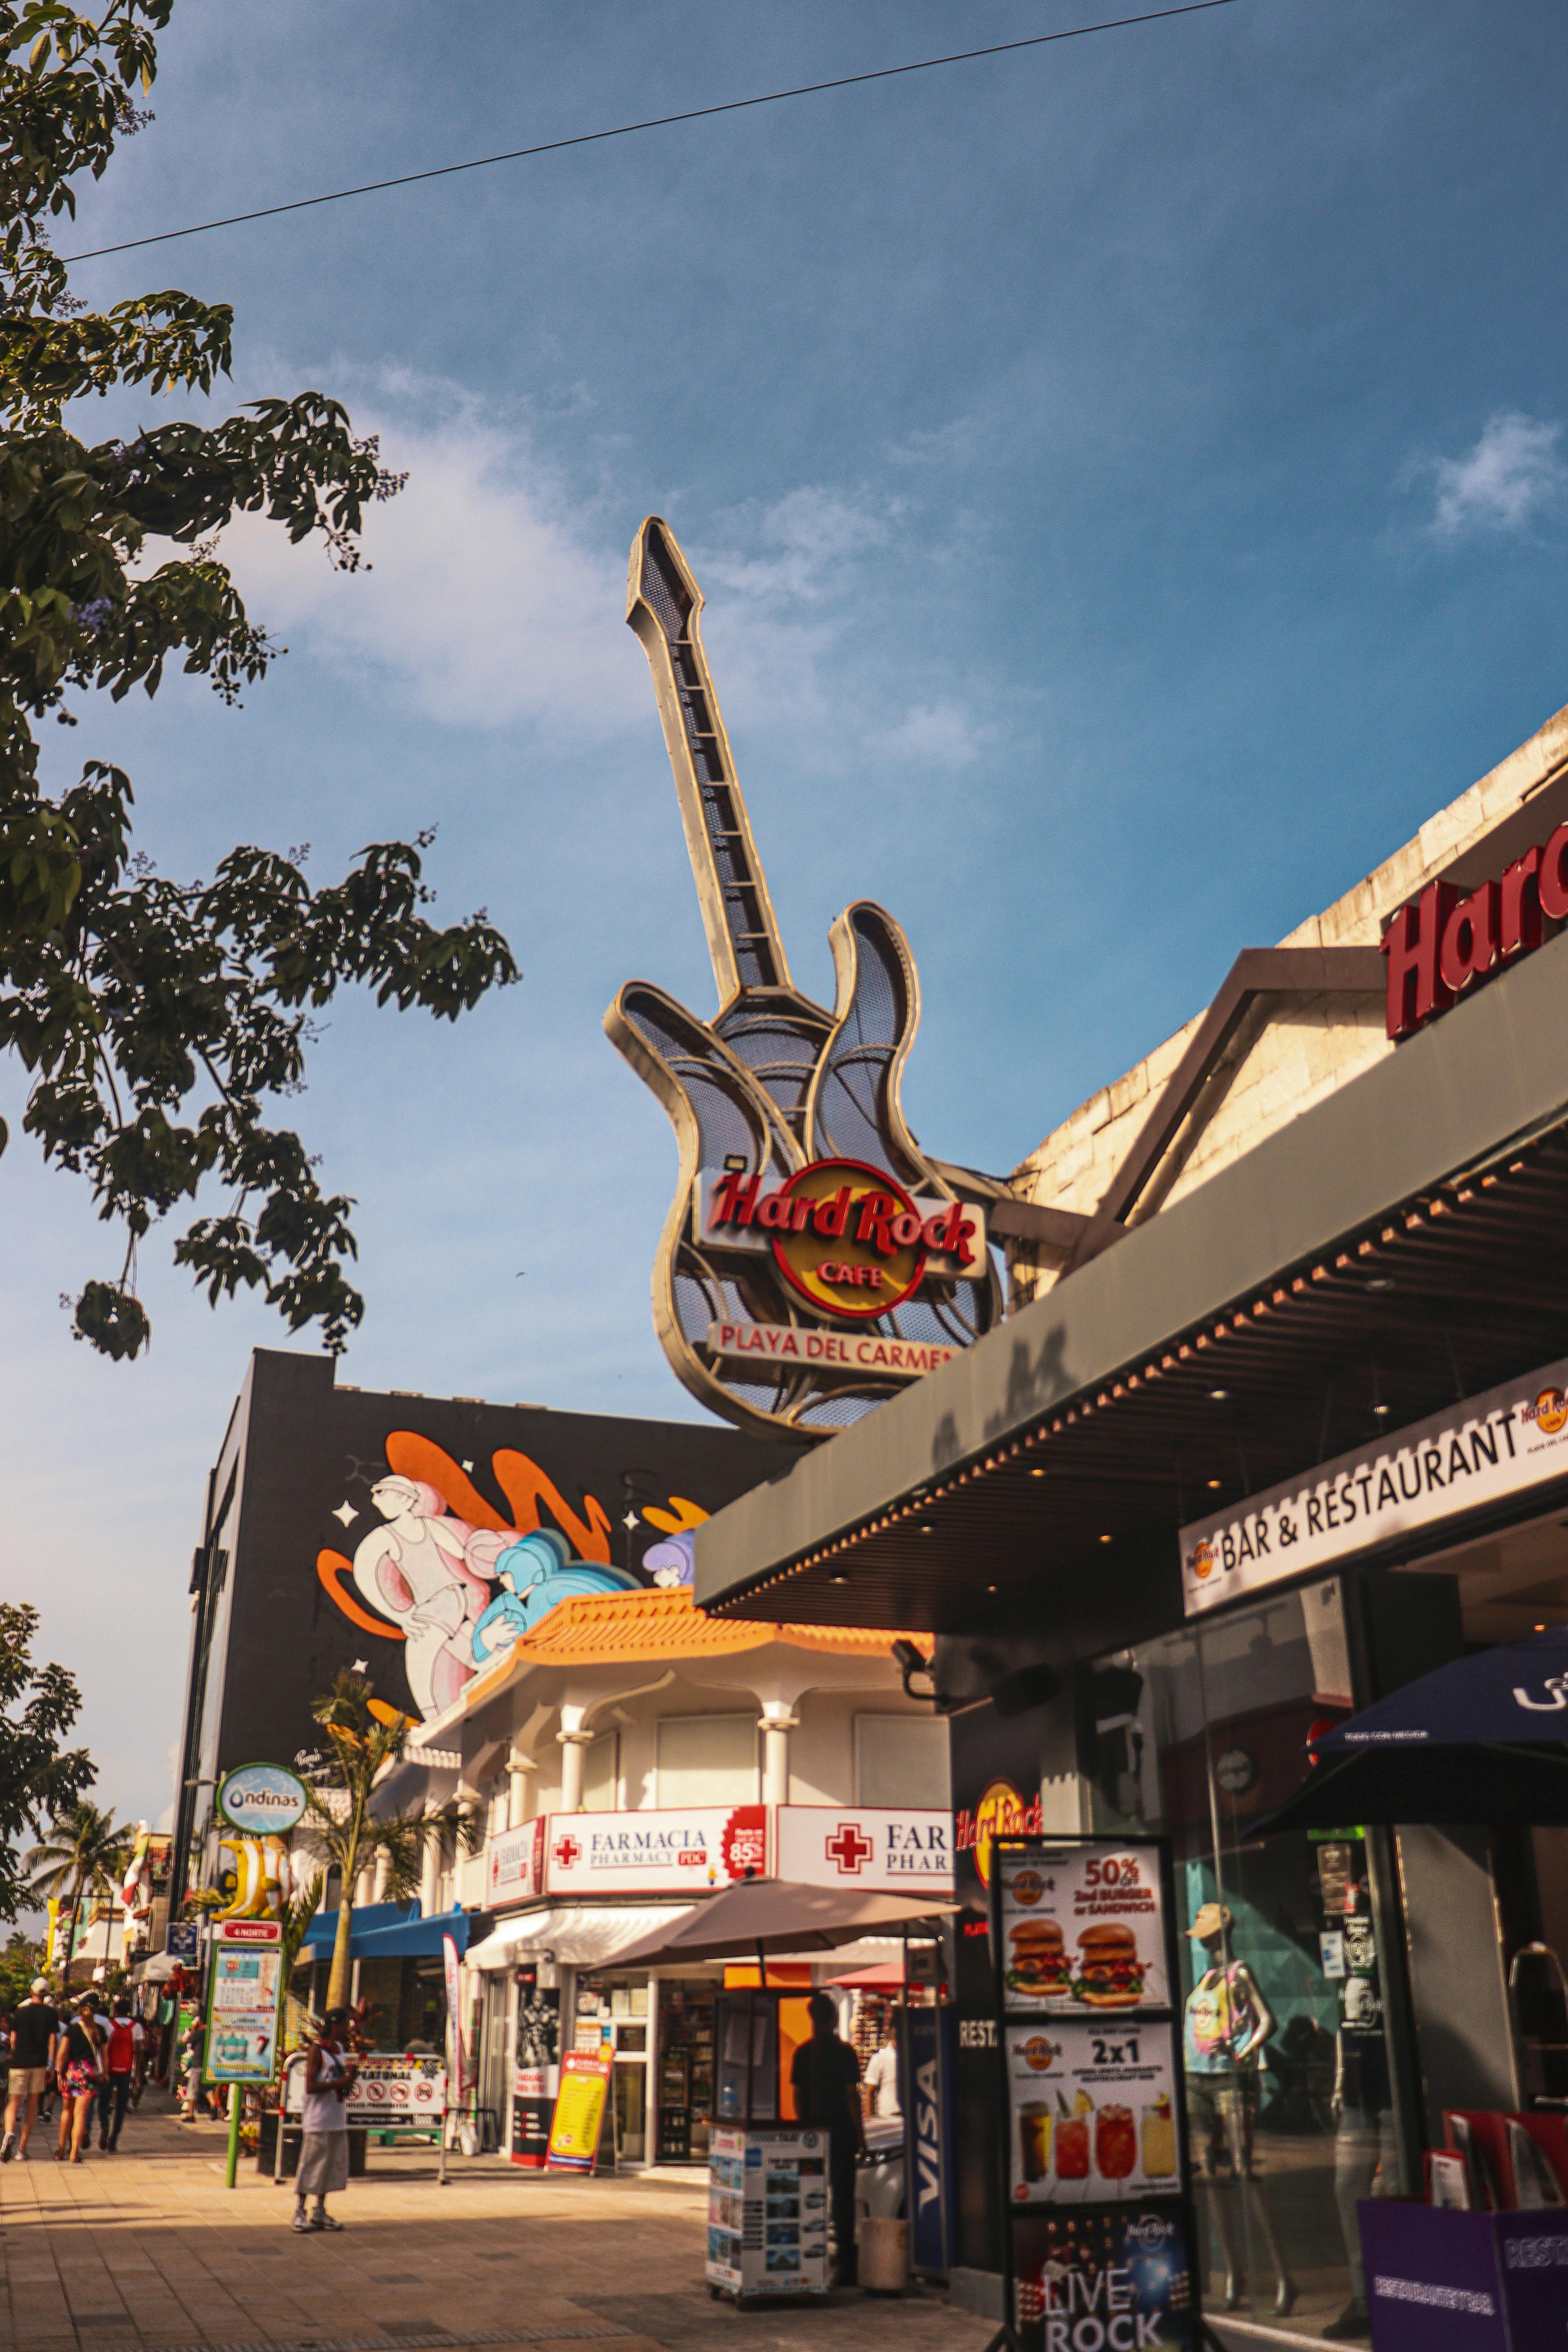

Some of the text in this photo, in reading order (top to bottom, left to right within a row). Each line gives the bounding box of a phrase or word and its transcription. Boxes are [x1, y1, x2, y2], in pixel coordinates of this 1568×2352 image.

[708, 1171, 976, 1266] Hard Rock
[817, 1260, 884, 1288] CAFE
[719, 1325, 798, 1356] PLAYA
[806, 1336, 849, 1362] DEL
[1220, 1412, 1516, 1571] BAR & RESTAURANT
[591, 1829, 707, 1850] FARMACIA
[886, 1824, 948, 1850] FAR
[955, 1801, 999, 1851] Hard
[590, 1851, 705, 1865] PHARMACY PDC
[886, 1852, 948, 1870] PHAR
[1085, 1858, 1140, 1886] 50%
[1088, 1902, 1155, 1914] SANDWICH
[240, 1928, 268, 1938] NORTE
[1091, 2037, 1140, 2063] 2x1
[916, 2059, 939, 2217] VISA
[1044, 2267, 1131, 2315] LIVE
[1045, 2312, 1164, 2352] ROCK
